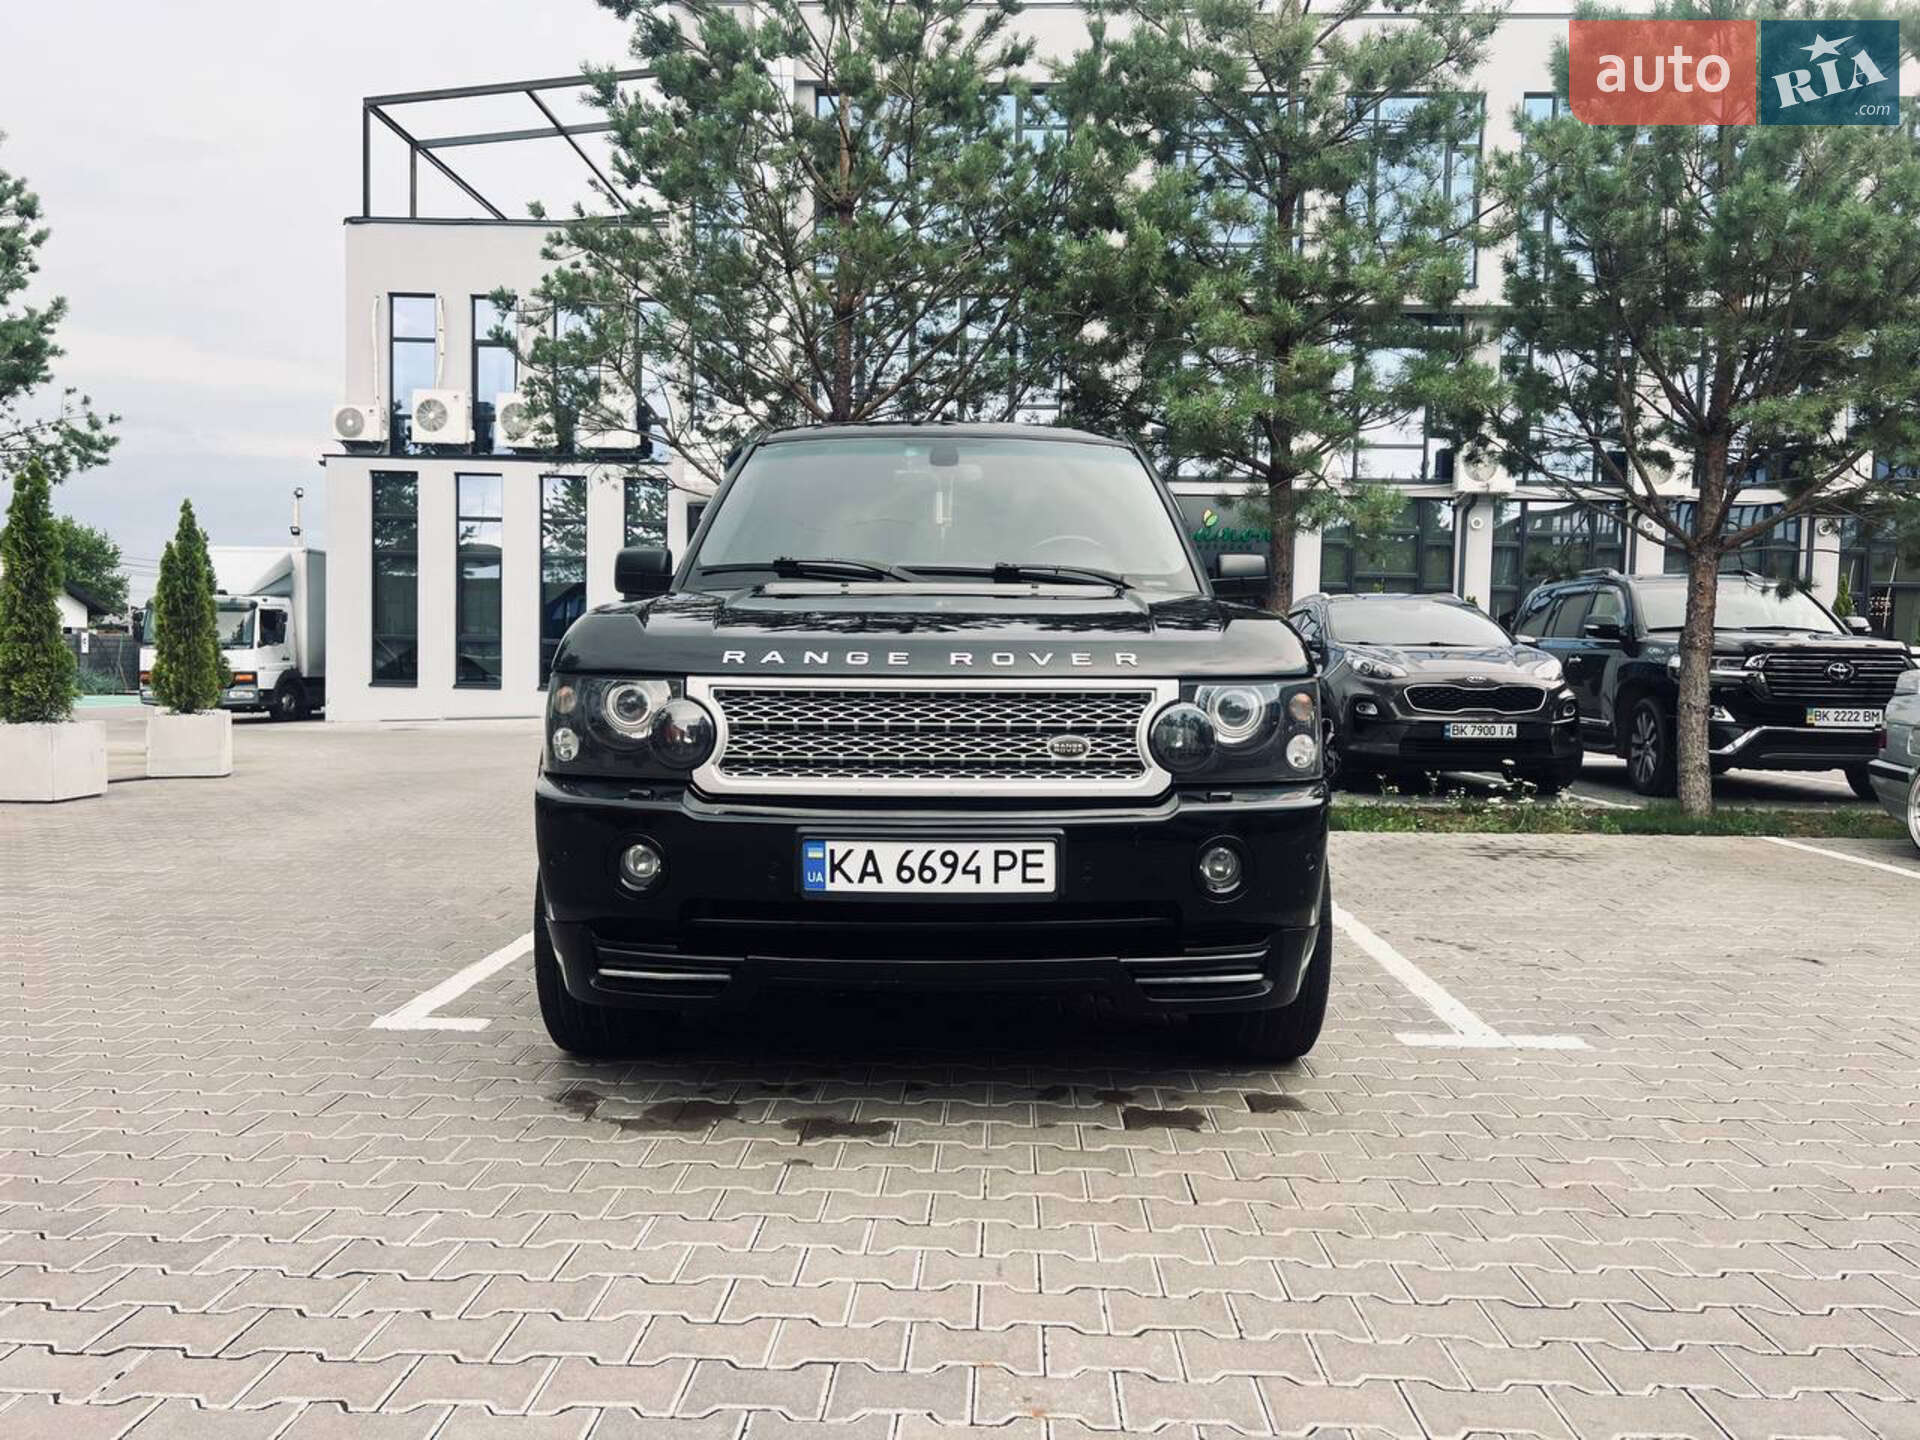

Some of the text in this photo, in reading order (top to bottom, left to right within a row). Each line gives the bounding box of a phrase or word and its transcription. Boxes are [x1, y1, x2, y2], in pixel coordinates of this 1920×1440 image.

[722, 650, 1139, 666] RANGE ROVER
[1814, 710, 1880, 722] BK 2222 BM
[1451, 725, 1514, 736] BK 7900 IA
[828, 849, 1045, 884] KA 6694 PE
[807, 871, 824, 883] UA
